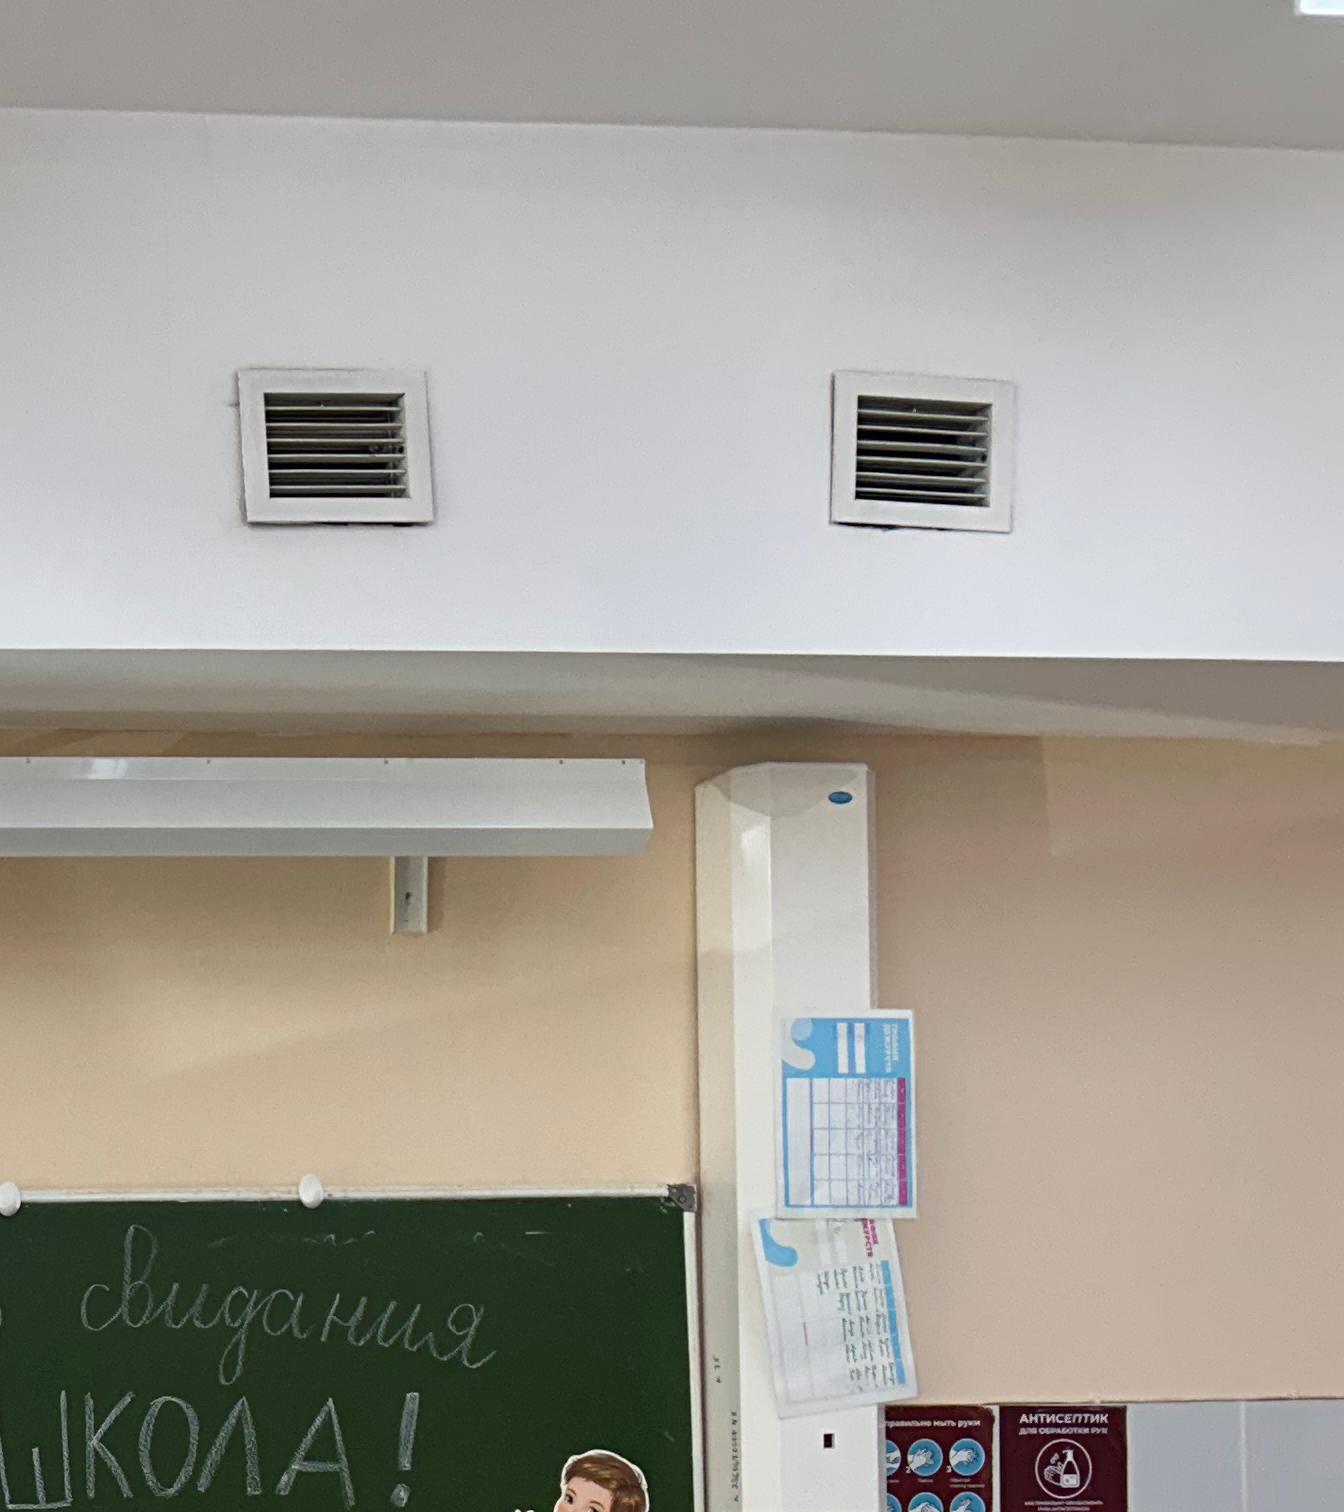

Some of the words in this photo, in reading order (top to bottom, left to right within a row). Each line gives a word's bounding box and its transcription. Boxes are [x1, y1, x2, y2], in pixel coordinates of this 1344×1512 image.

[80, 1225, 496, 1385] свидания
[958, 1420, 981, 1428] руки
[1019, 1414, 1109, 1425] АНТИСЕПТИК
[1018, 1428, 1038, 1436] ДЛЯ
